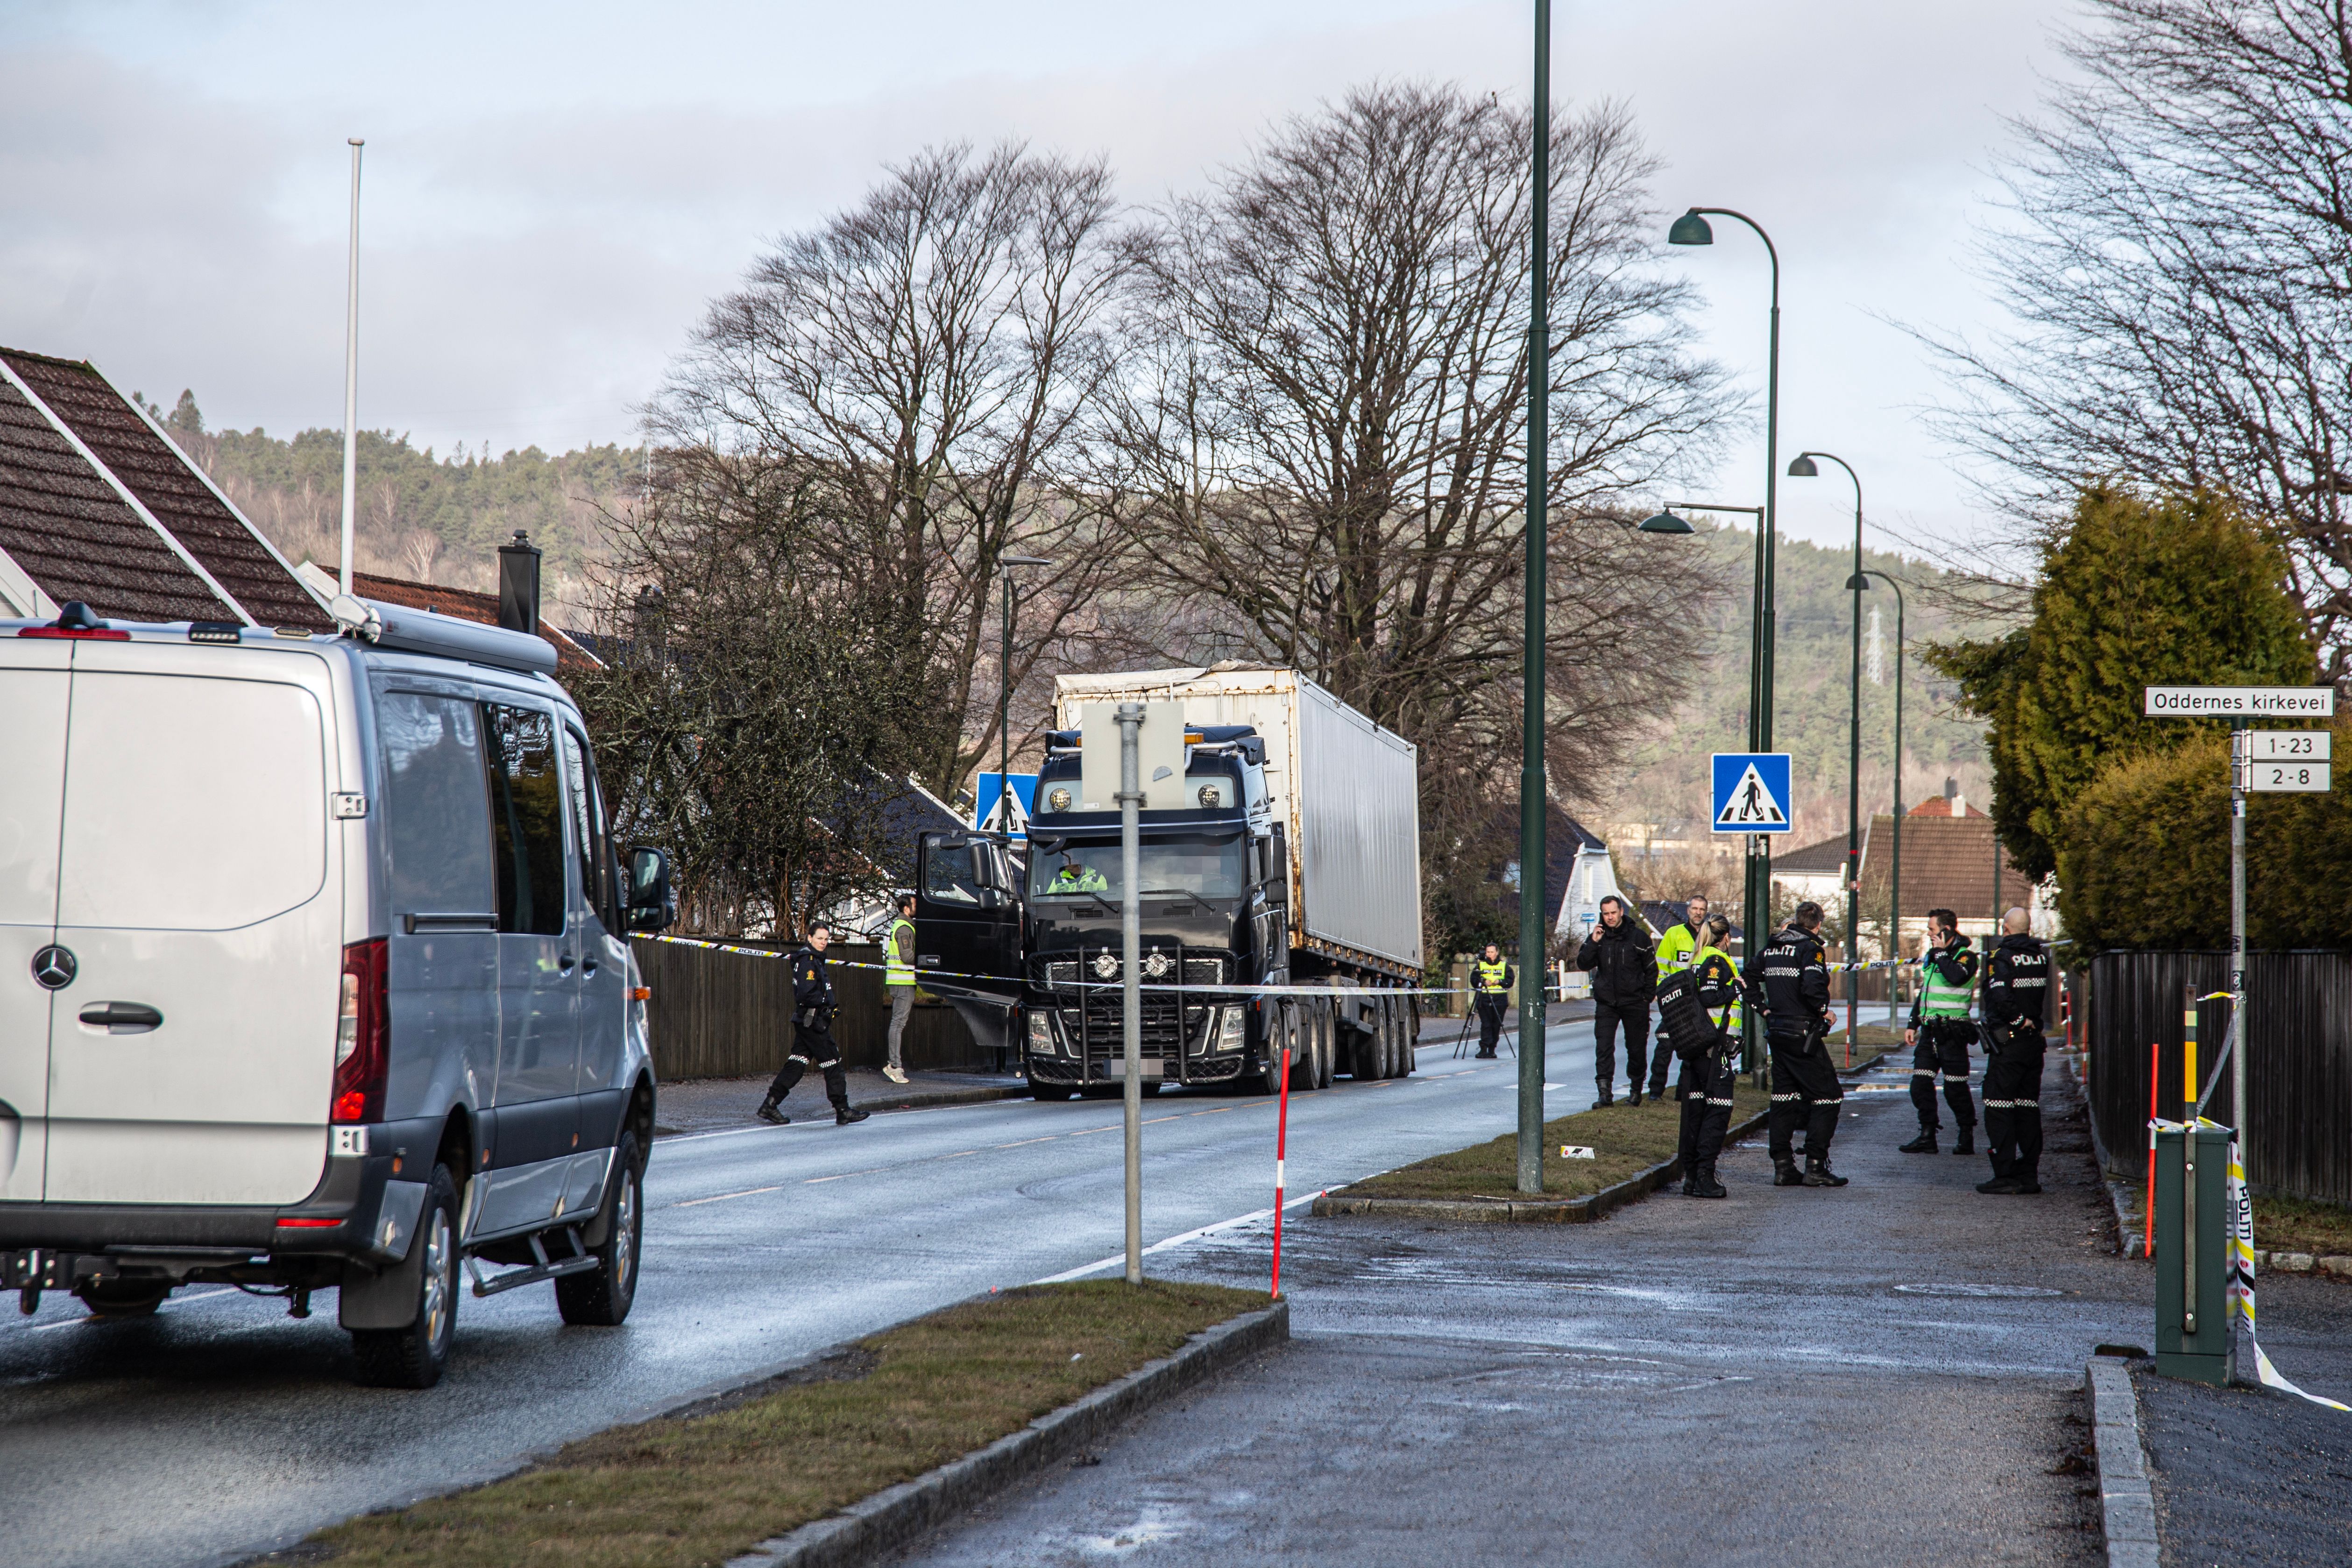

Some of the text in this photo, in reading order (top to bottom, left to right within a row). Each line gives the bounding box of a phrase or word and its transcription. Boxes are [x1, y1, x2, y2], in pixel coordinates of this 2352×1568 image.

[2154, 693, 2324, 710] Oddernes kirkevei
[1661, 988, 1682, 1006] POLITI
[2239, 1185, 2251, 1240] POLITI
